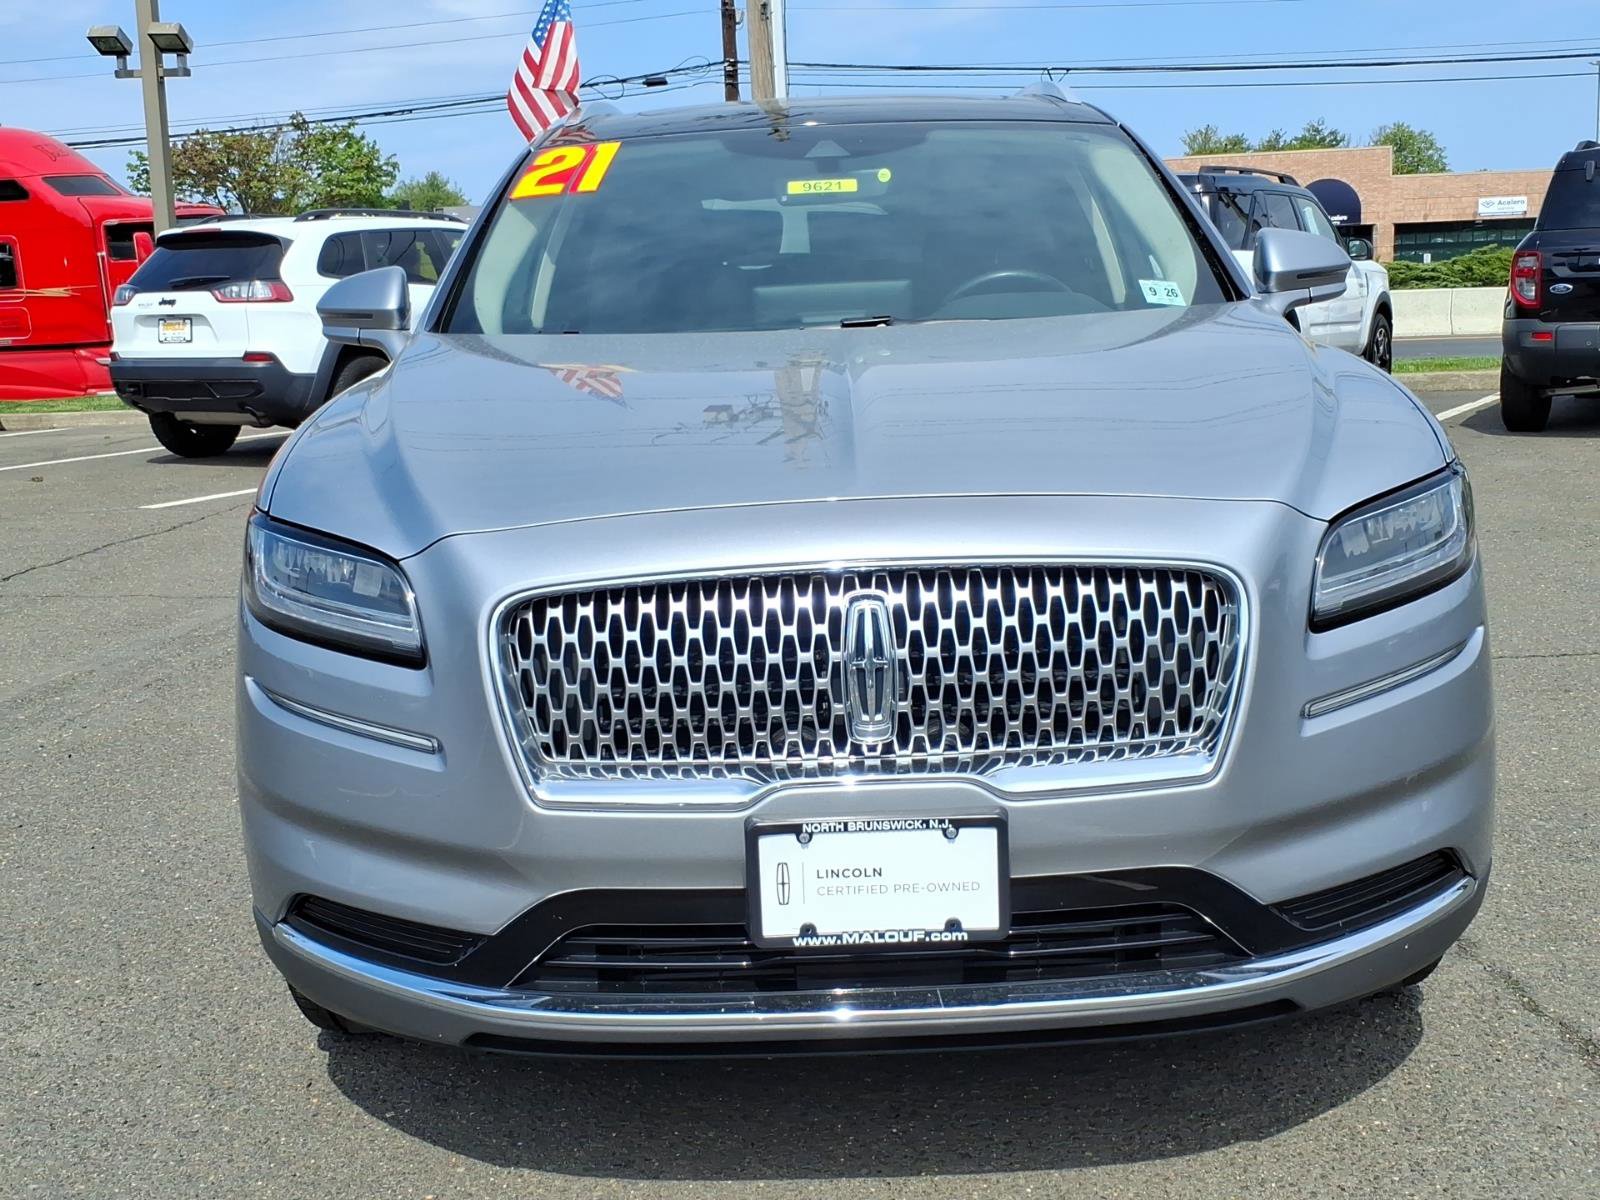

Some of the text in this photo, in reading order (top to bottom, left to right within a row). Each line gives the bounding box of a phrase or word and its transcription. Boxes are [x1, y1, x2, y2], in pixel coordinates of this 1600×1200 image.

[511, 141, 621, 199] 21
[802, 181, 842, 192] 9621
[1148, 286, 1178, 298] 9 26
[158, 297, 176, 307] Jeep
[802, 822, 844, 834] NORTH
[816, 867, 883, 879] LINCOLN
[817, 881, 981, 896] CERTIFIED PRE-OWNED
[793, 929, 968, 947] www.MALOUF.com
